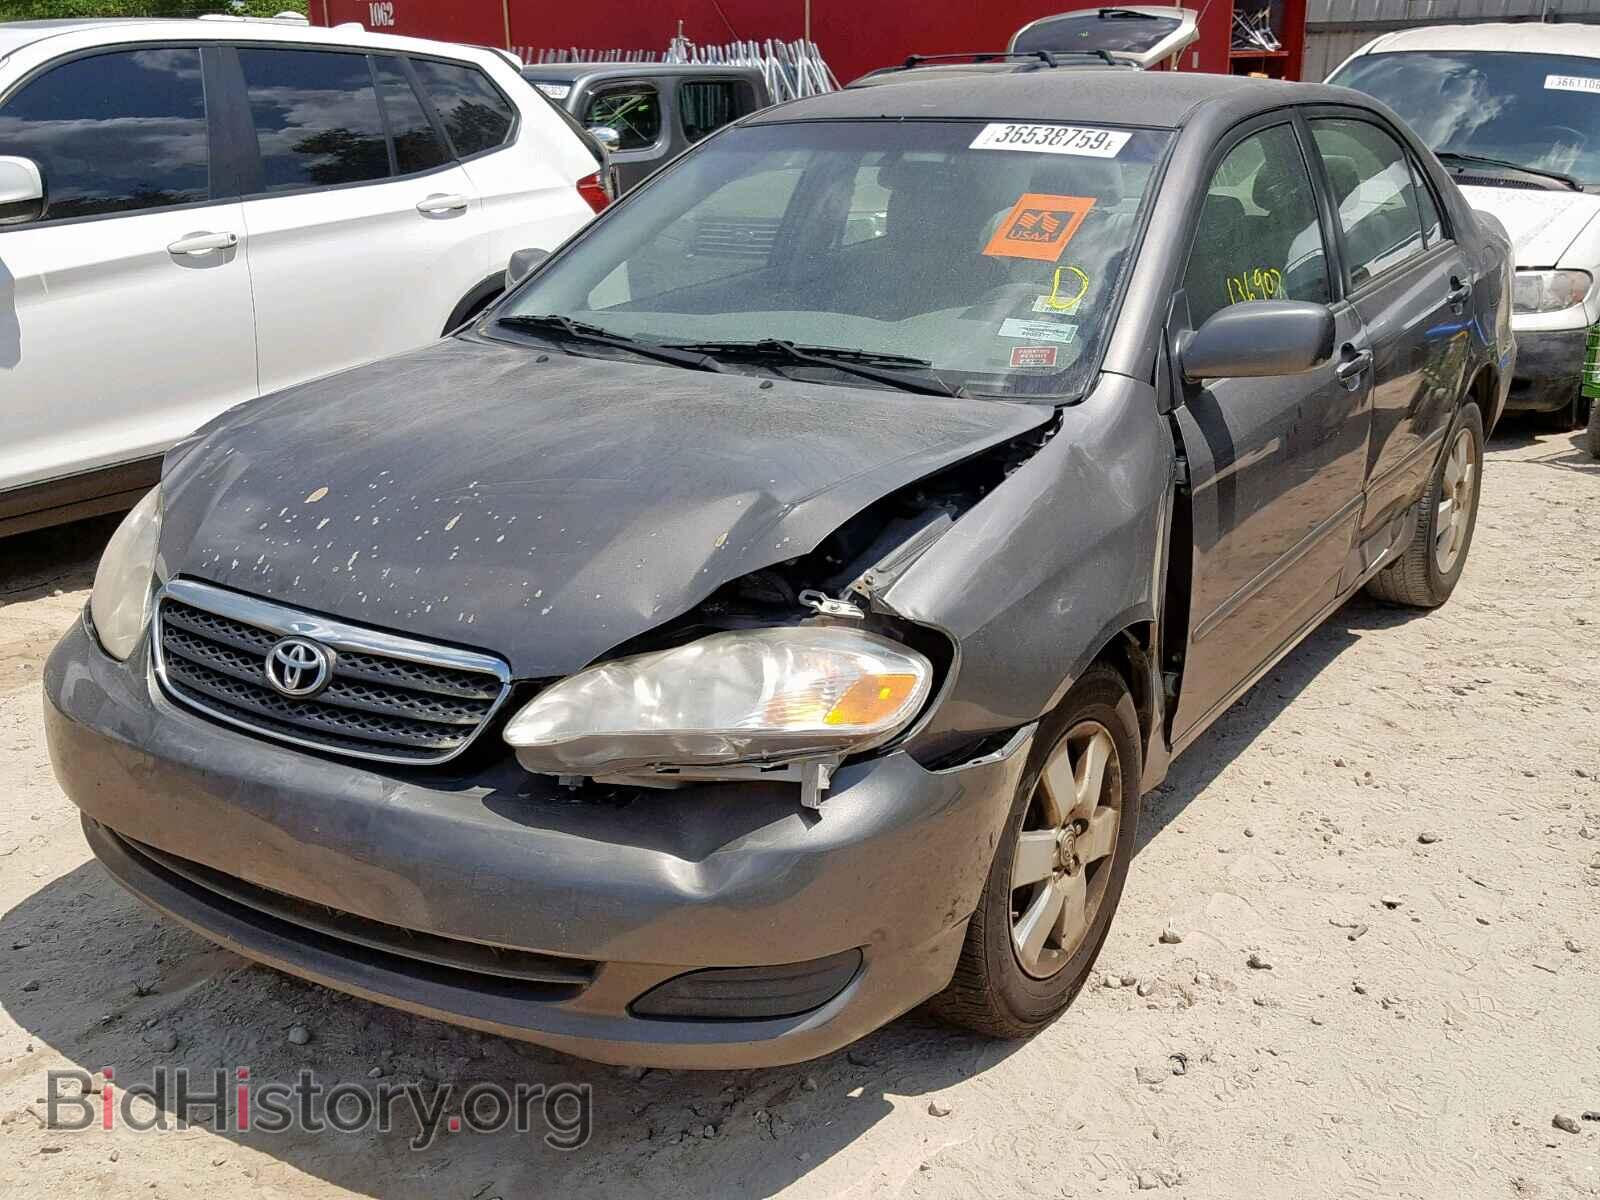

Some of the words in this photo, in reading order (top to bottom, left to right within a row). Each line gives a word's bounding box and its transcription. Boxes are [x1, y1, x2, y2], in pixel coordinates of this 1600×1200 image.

[369, 2, 395, 26] 1062
[996, 125, 1109, 150] 36538759
[1008, 230, 1051, 242] USAA
[1048, 265, 1089, 309] D
